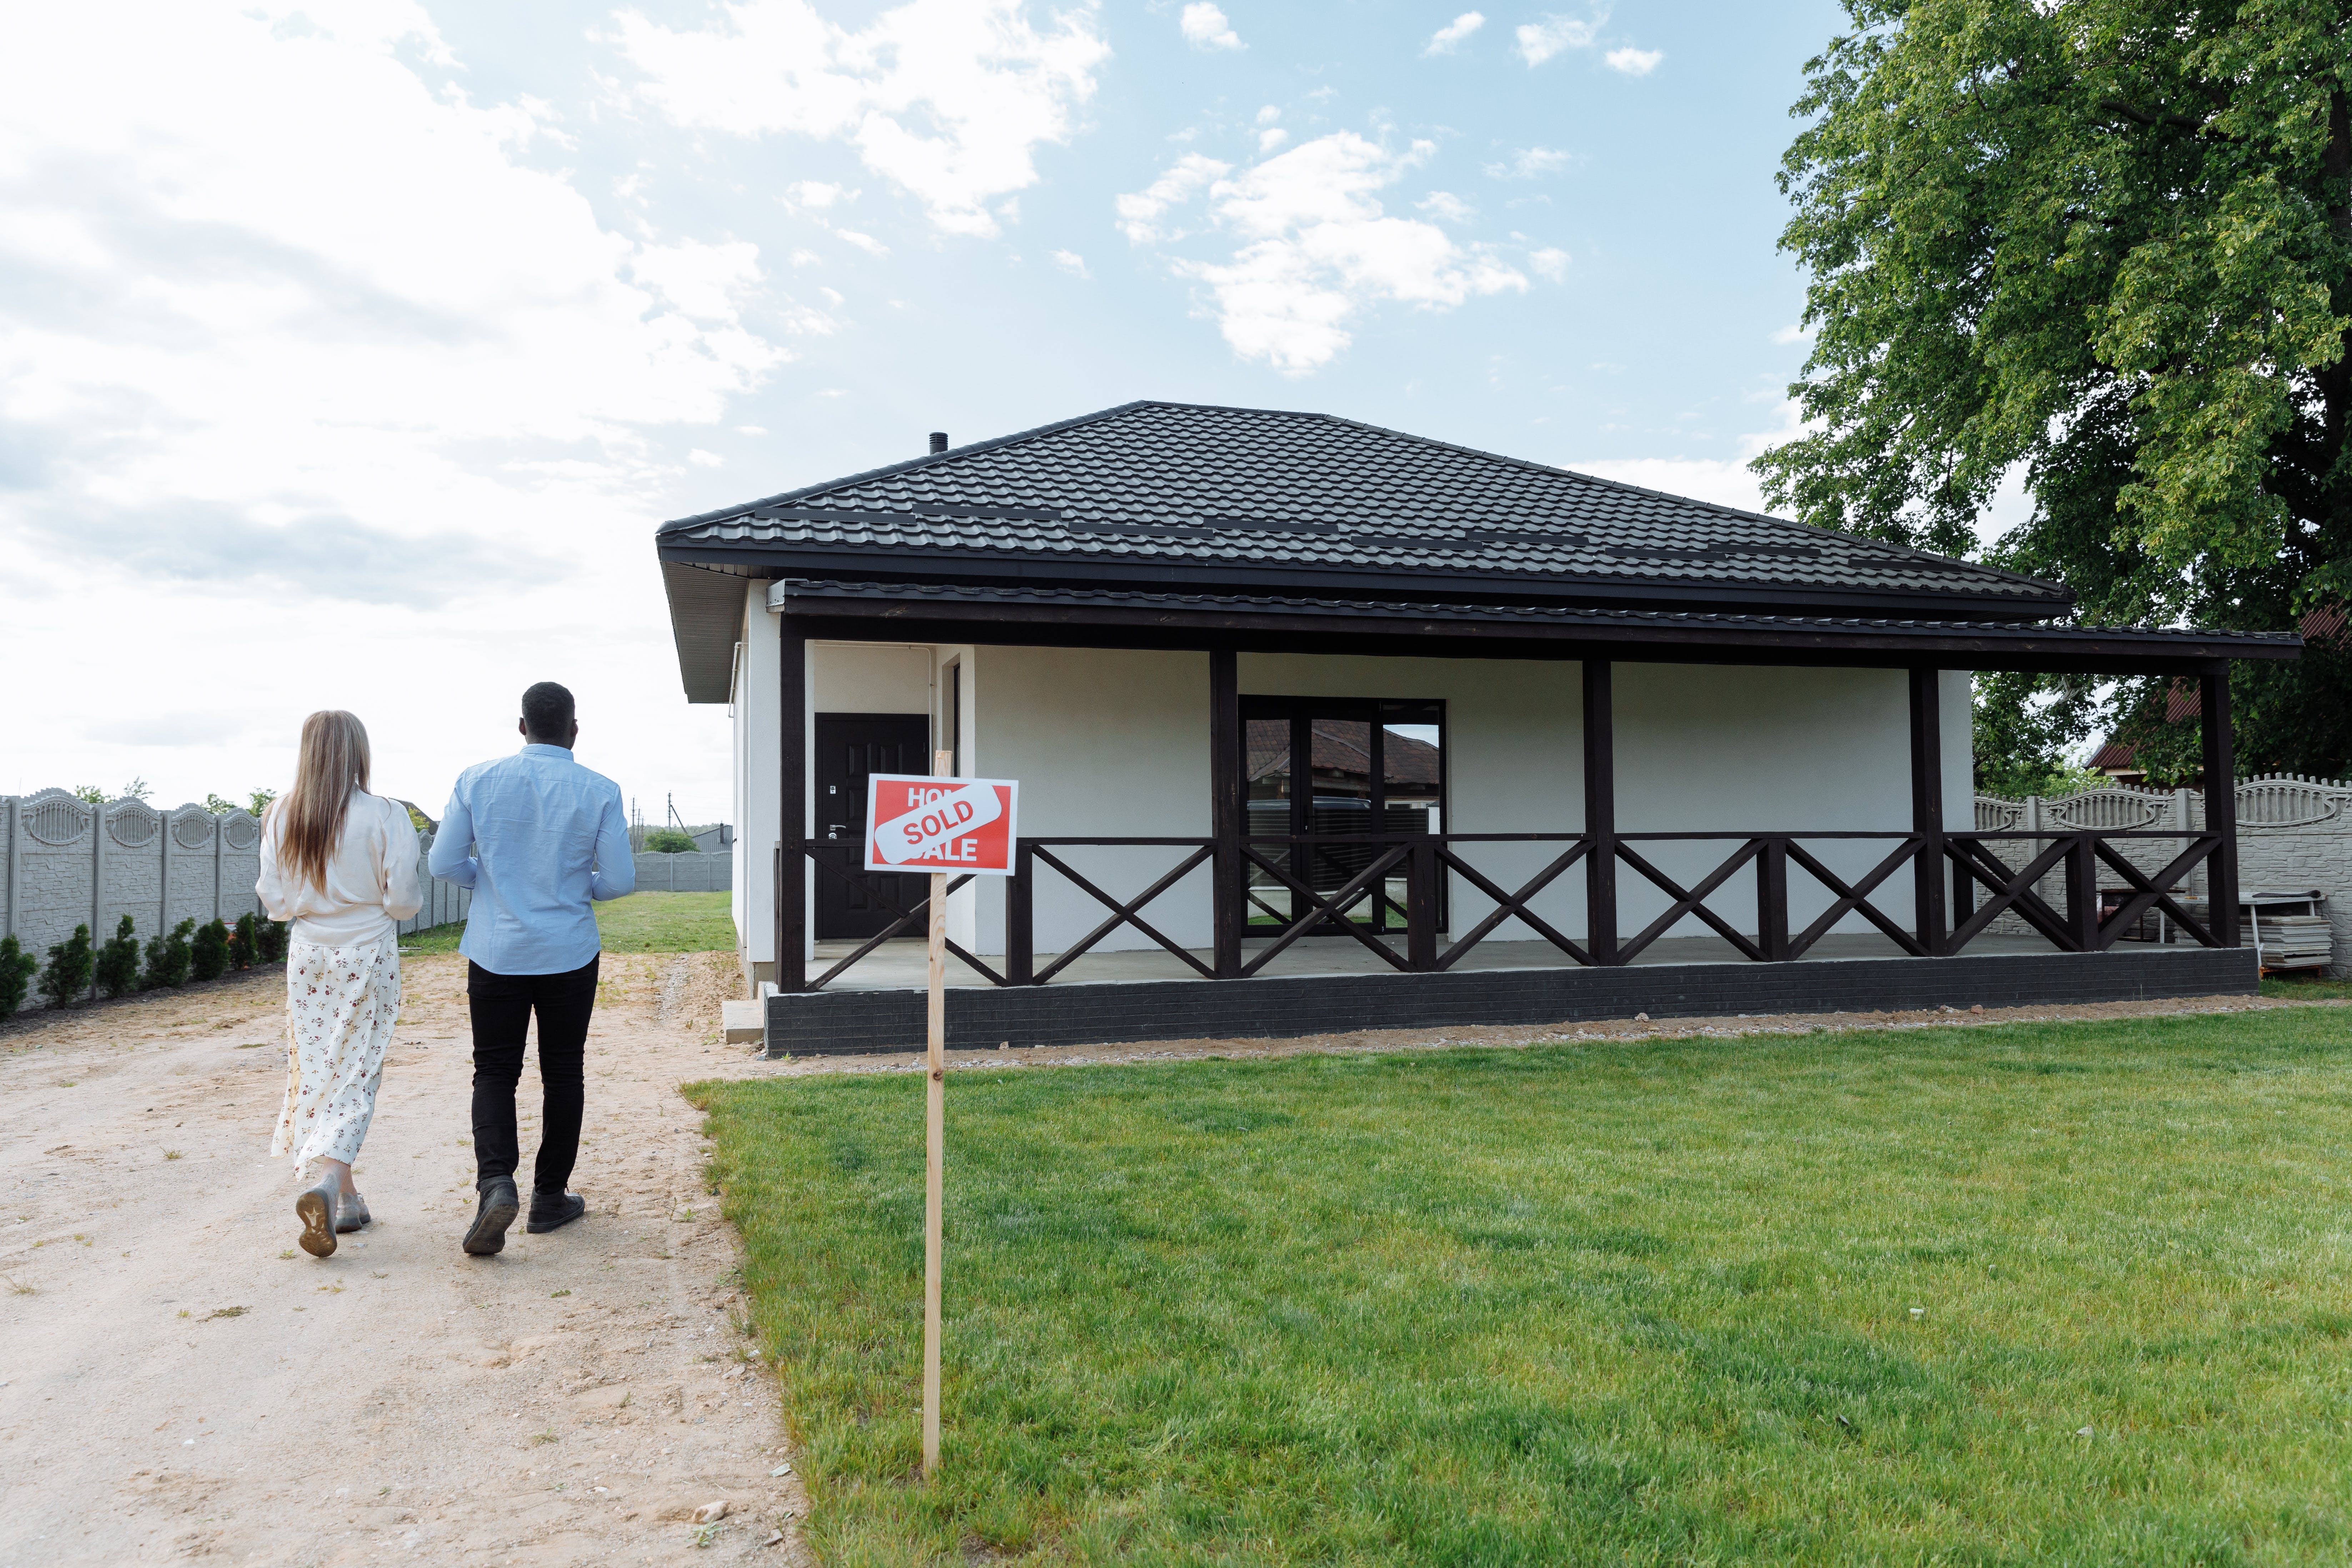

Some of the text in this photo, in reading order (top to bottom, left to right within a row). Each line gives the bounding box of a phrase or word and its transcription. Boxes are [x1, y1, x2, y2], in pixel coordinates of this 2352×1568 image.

[908, 787, 952, 807] HO
[903, 800, 973, 845] SOLD
[910, 838, 978, 861] ALE
